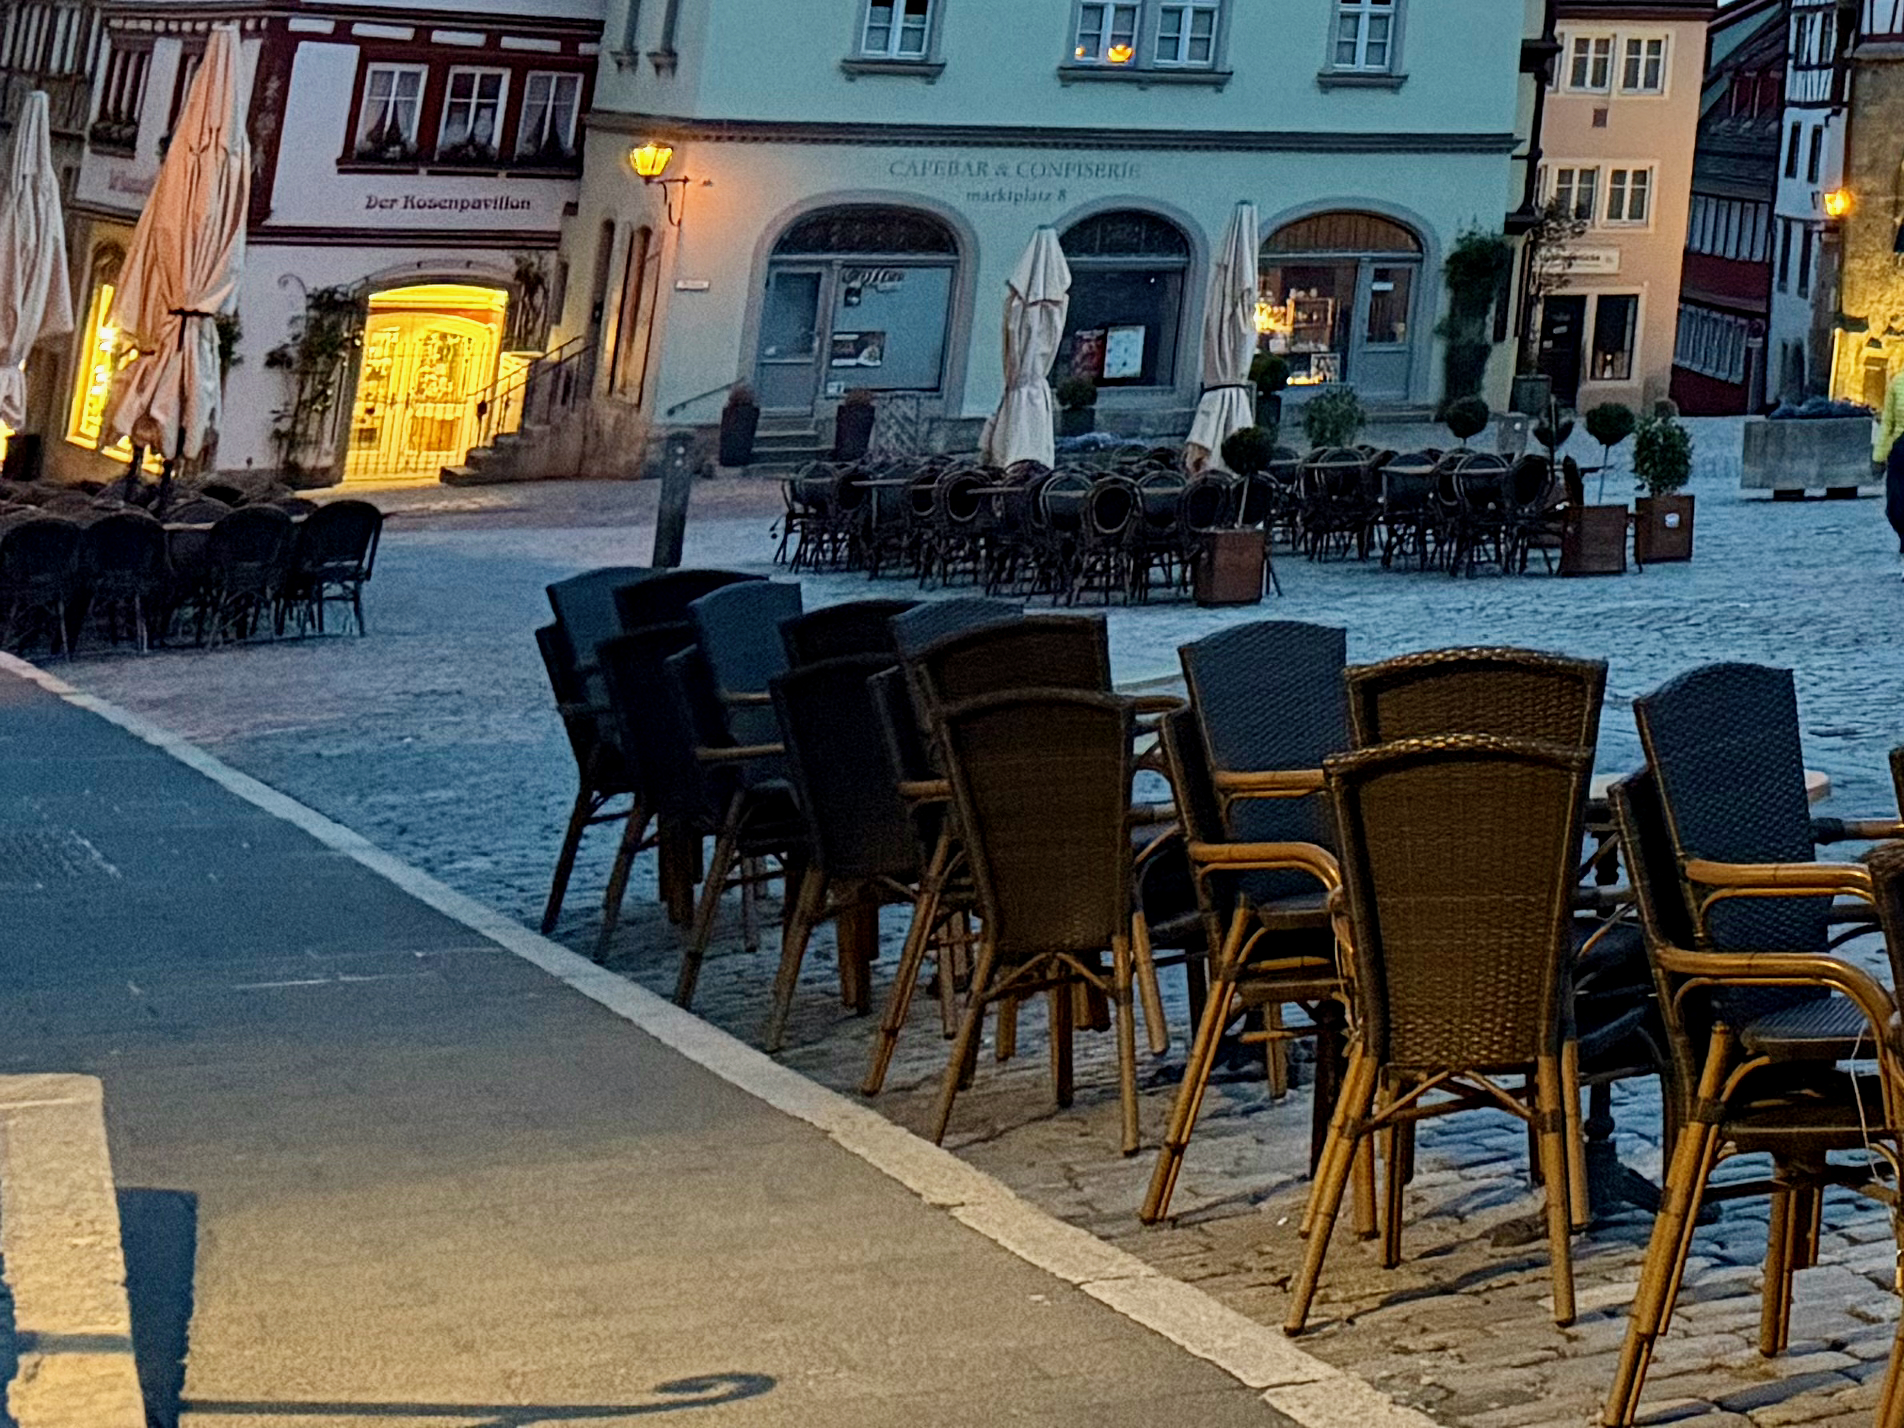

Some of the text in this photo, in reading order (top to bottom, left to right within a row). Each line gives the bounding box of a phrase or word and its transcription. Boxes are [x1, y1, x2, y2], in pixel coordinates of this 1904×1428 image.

[994, 163, 1008, 178] &
[1016, 160, 1141, 180] CONFISERIE
[365, 195, 398, 210] Der
[966, 187, 1051, 205] marktplatz
